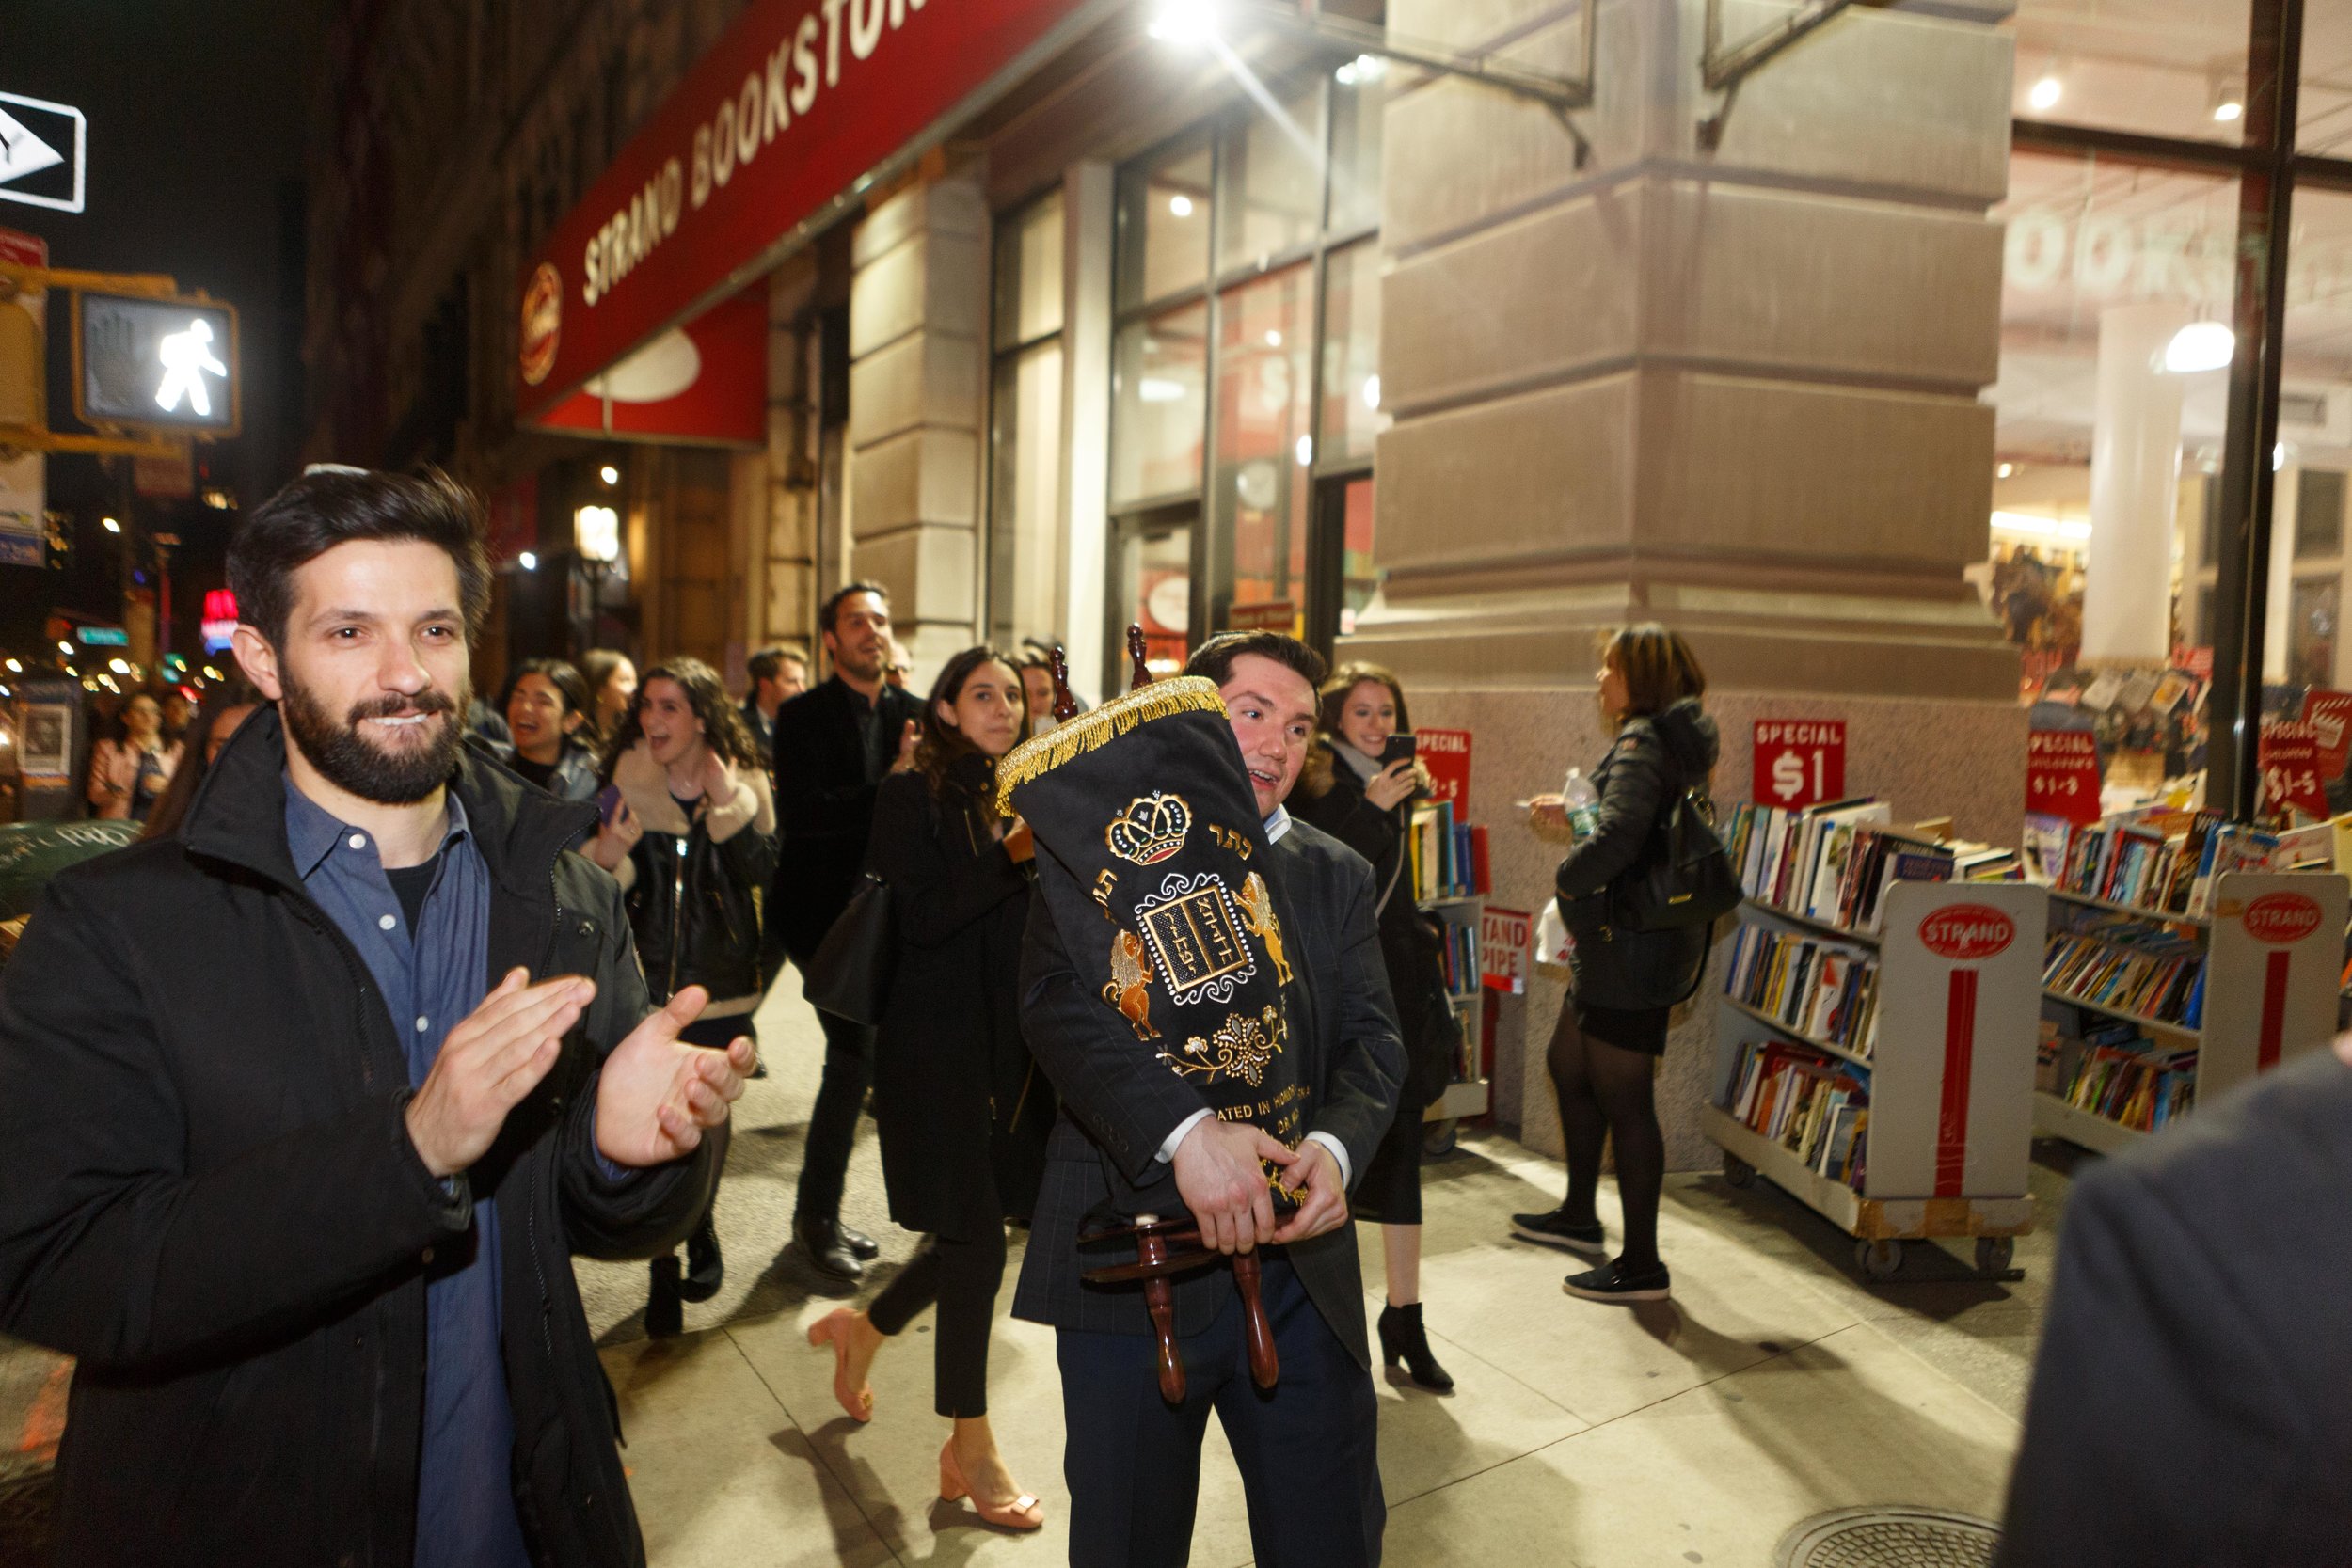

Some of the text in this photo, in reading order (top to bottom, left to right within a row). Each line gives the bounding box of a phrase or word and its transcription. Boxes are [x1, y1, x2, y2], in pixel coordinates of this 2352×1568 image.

[582, 0, 927, 308] STRAND BOOKSTO
[1756, 724, 1842, 745] SPECIAL
[1772, 750, 1824, 801] $1
[1209, 823, 1253, 862] כתר
[2249, 908, 2317, 927] STRAND
[1925, 922, 2010, 943] STRAND
[1258, 1101, 1271, 1116] IN
